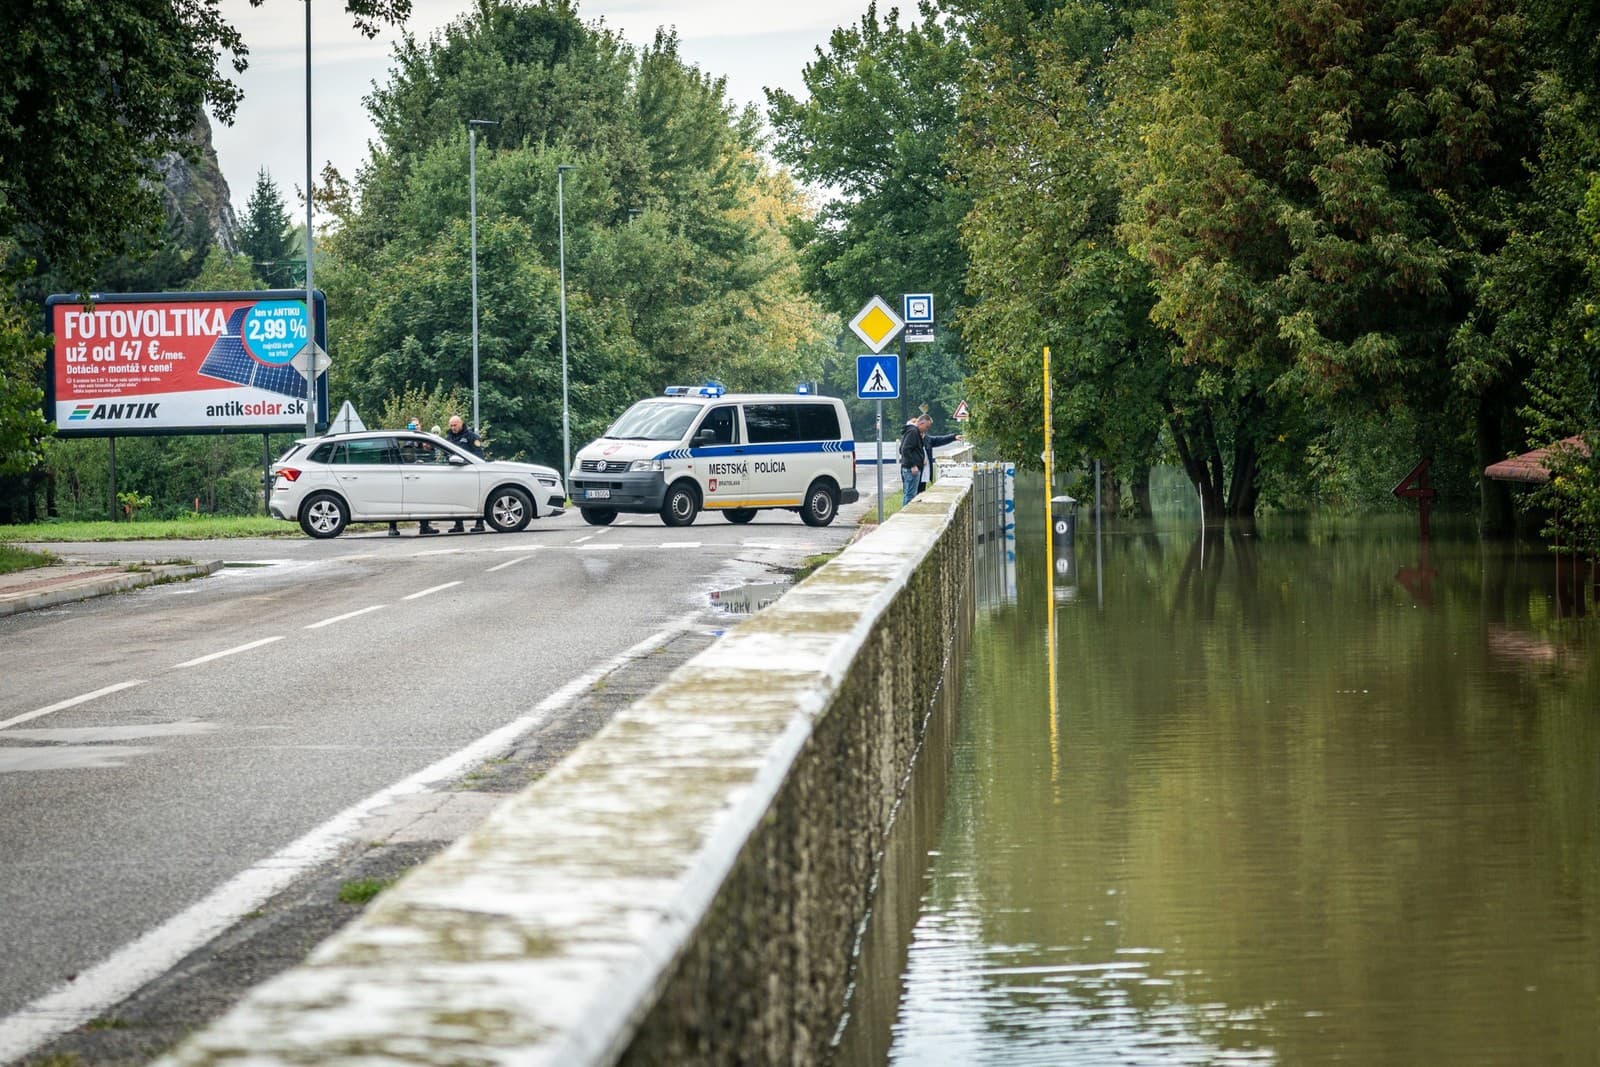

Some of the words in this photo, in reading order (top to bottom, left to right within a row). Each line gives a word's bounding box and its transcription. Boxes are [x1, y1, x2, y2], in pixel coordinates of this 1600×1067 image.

[273, 307, 300, 317] ANTIKU
[65, 308, 228, 339] FOTOVOLTIKA
[249, 318, 286, 342] 2,99
[290, 318, 307, 339] %
[66, 342, 88, 362] už
[92, 341, 116, 361] od
[120, 340, 142, 361] 47
[66, 364, 99, 375] Dotácia
[108, 363, 139, 374] montáž
[141, 365, 148, 373] v
[149, 362, 173, 373] cene!
[91, 403, 160, 420] ANTIK
[206, 400, 305, 417] antiksolar.sk
[709, 459, 748, 475] MESTSKÁ
[755, 459, 786, 473] POLÍCIA
